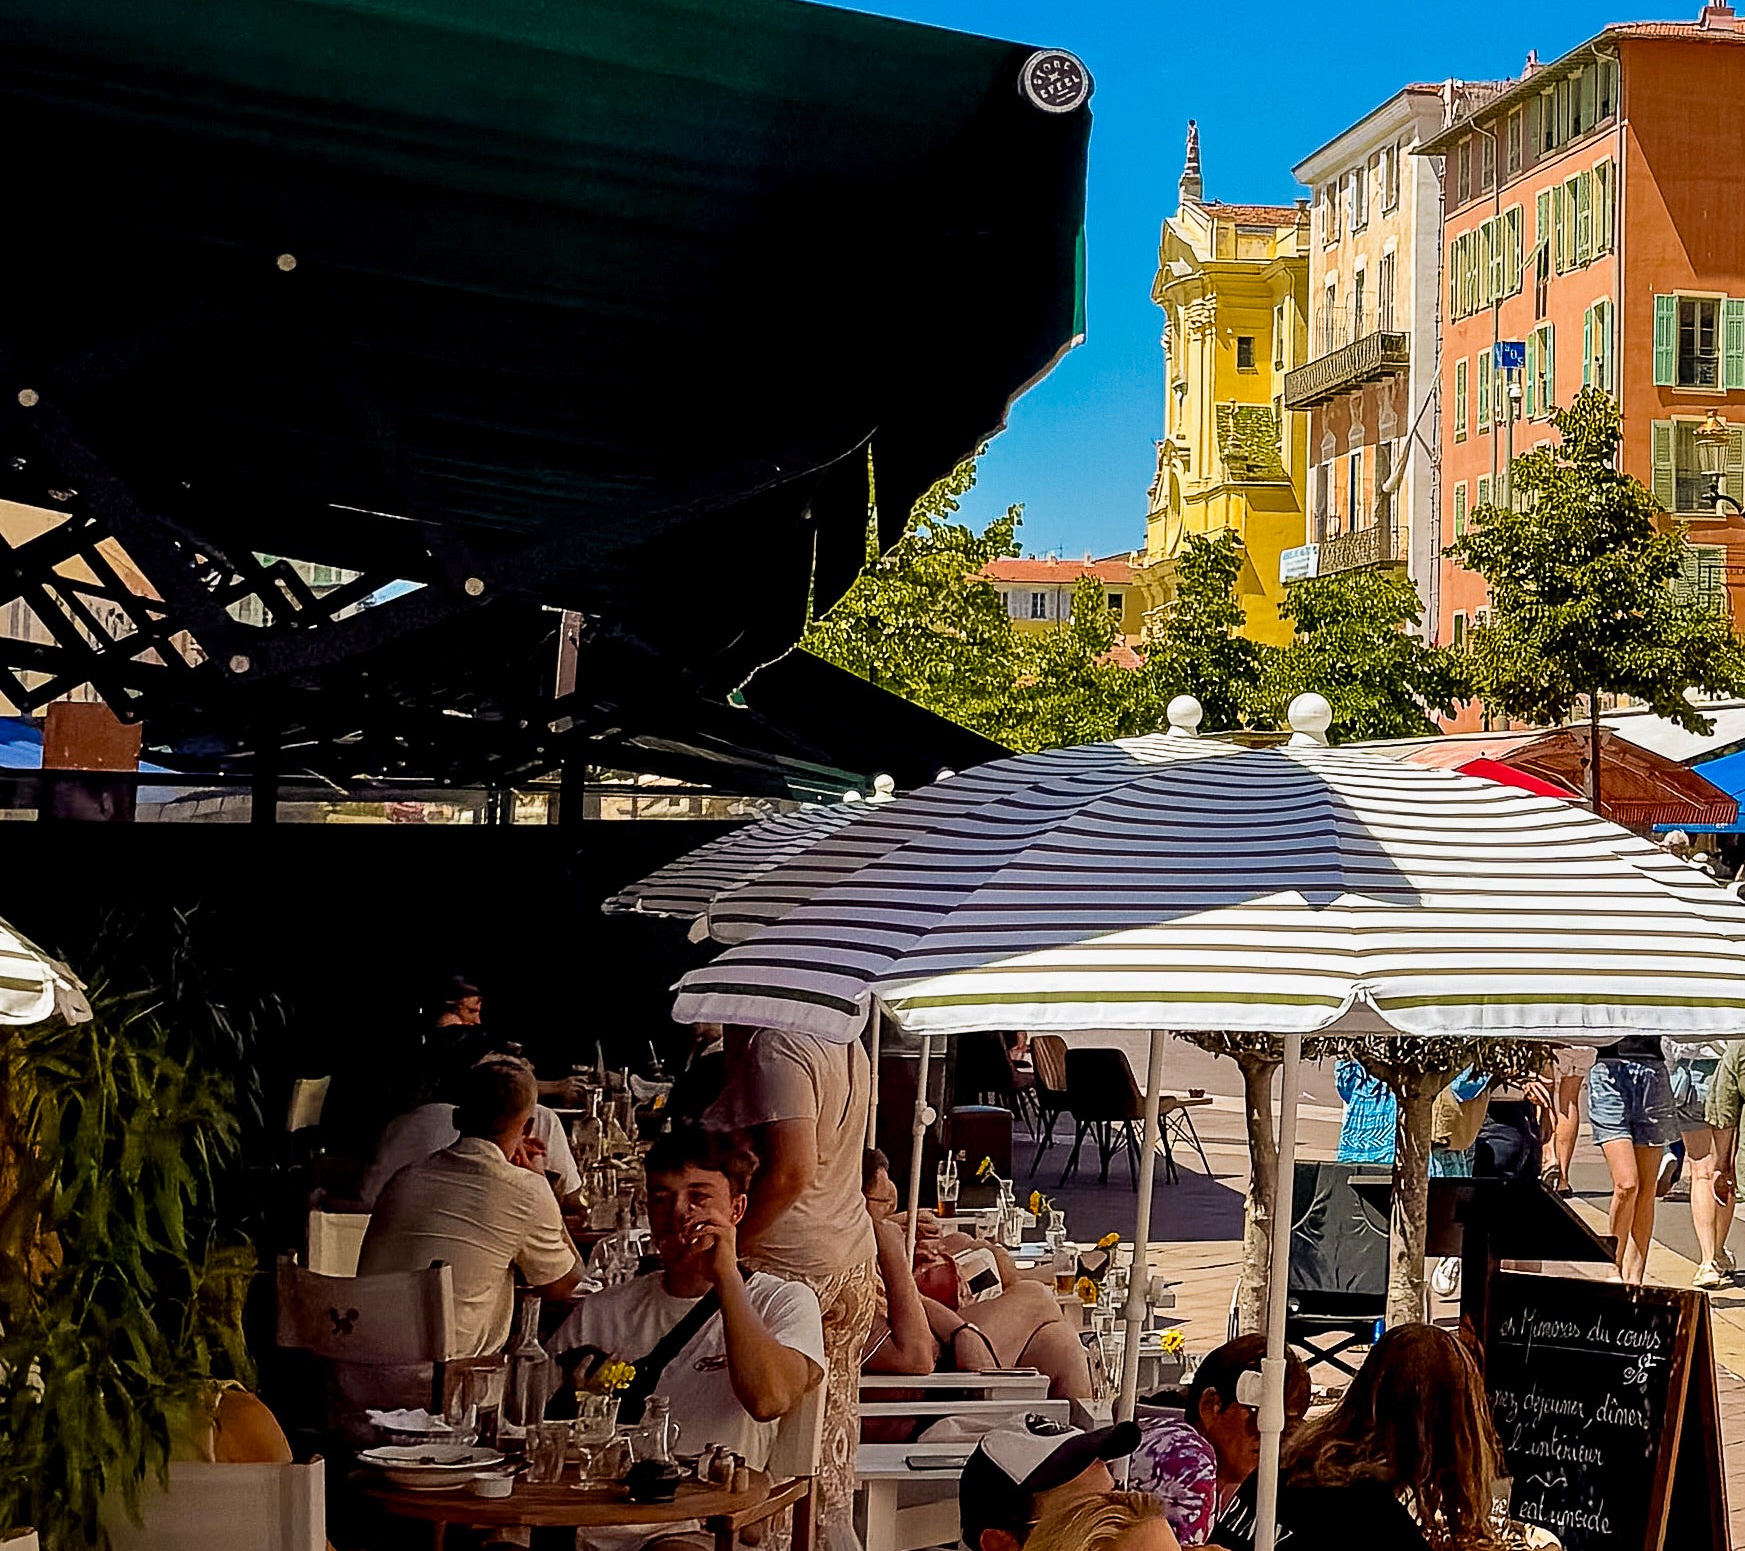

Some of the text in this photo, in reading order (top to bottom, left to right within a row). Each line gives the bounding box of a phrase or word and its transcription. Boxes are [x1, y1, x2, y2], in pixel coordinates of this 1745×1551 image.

[1500, 1317, 1516, 1337] es
[1586, 1314, 1611, 1343] du
[1616, 1328, 1661, 1349] cours
[1519, 1491, 1549, 1521] eat
